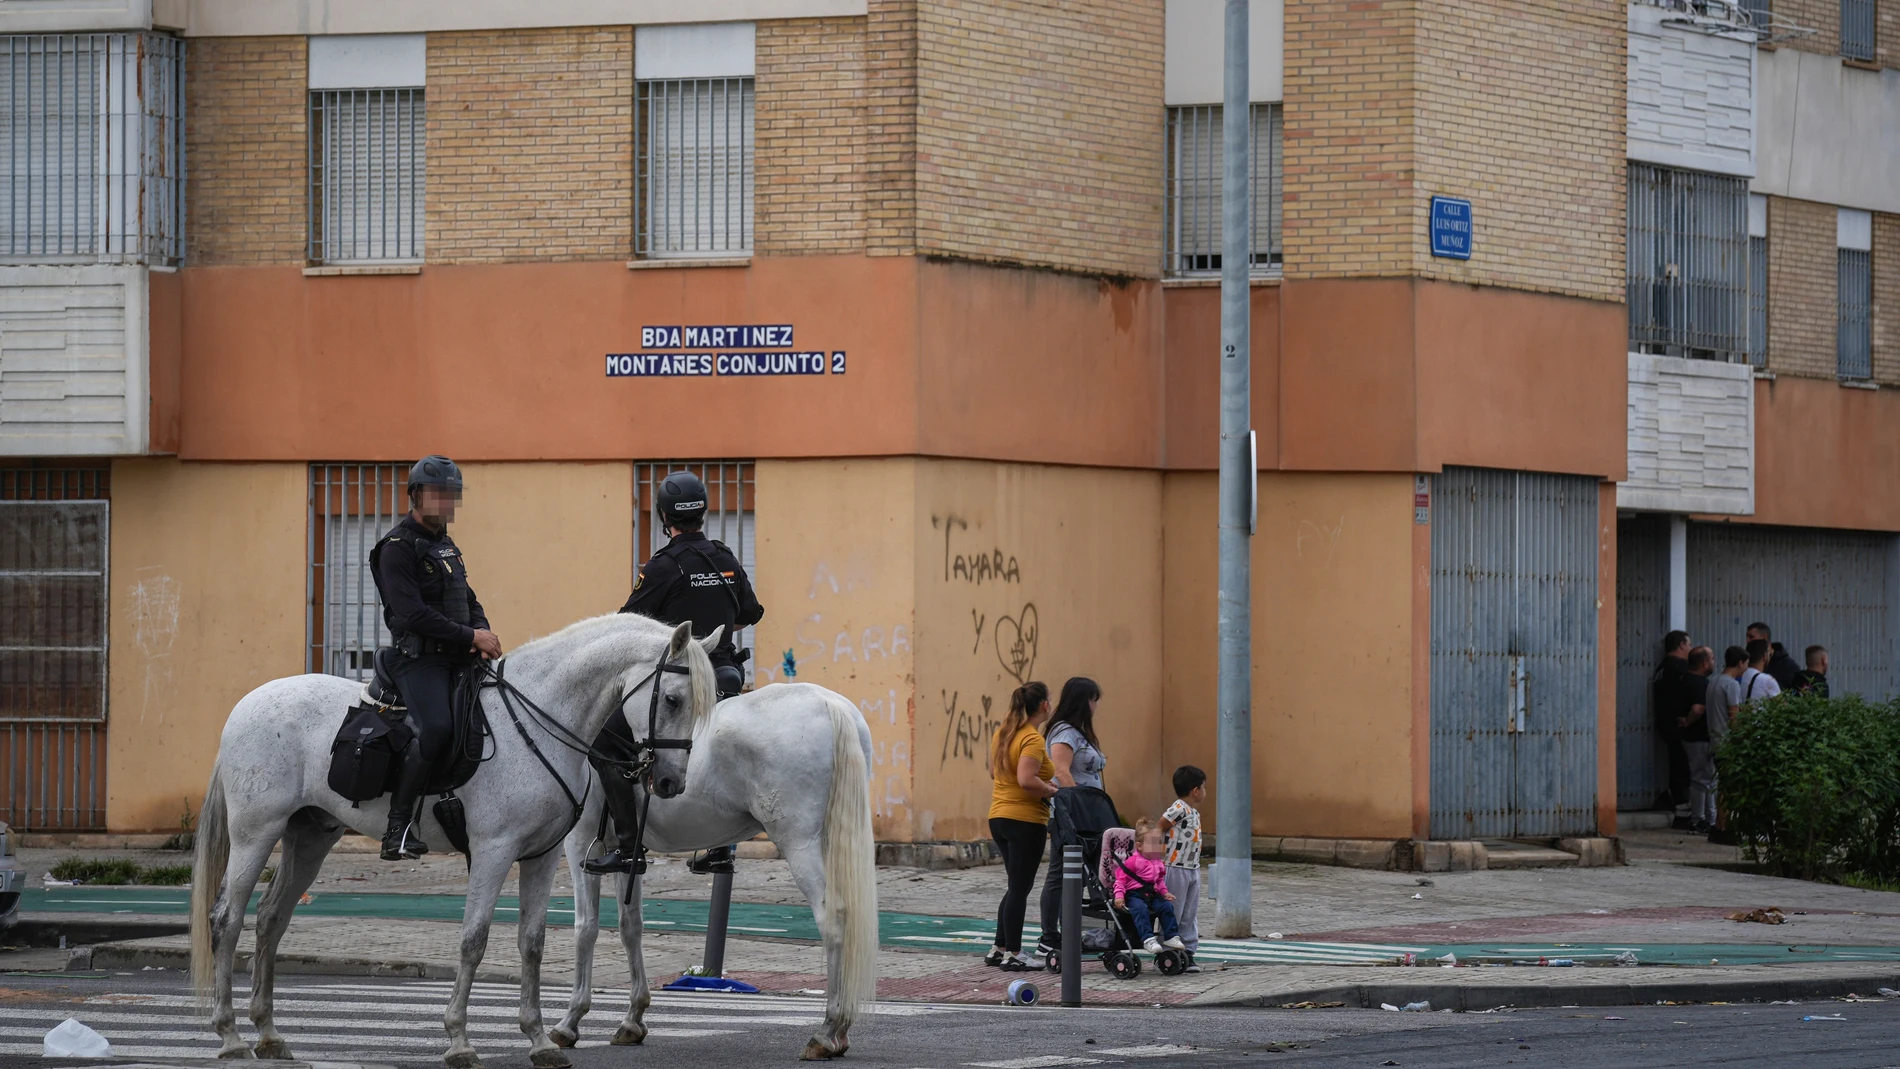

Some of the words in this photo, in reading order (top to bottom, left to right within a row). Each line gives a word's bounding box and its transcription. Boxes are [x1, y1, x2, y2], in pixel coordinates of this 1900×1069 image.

[1443, 204, 1461, 216] CALLE
[1436, 218, 1450, 230] LUIS
[1450, 220, 1469, 232] ORTIZ
[642, 327, 681, 346] BDA
[685, 326, 792, 346] MARTINEZ
[1225, 344, 1236, 358] 2
[606, 355, 712, 375] MONTAÑES
[717, 353, 824, 374] CONJUNTO
[832, 353, 845, 372] 2
[690, 572, 725, 581] POLIC
